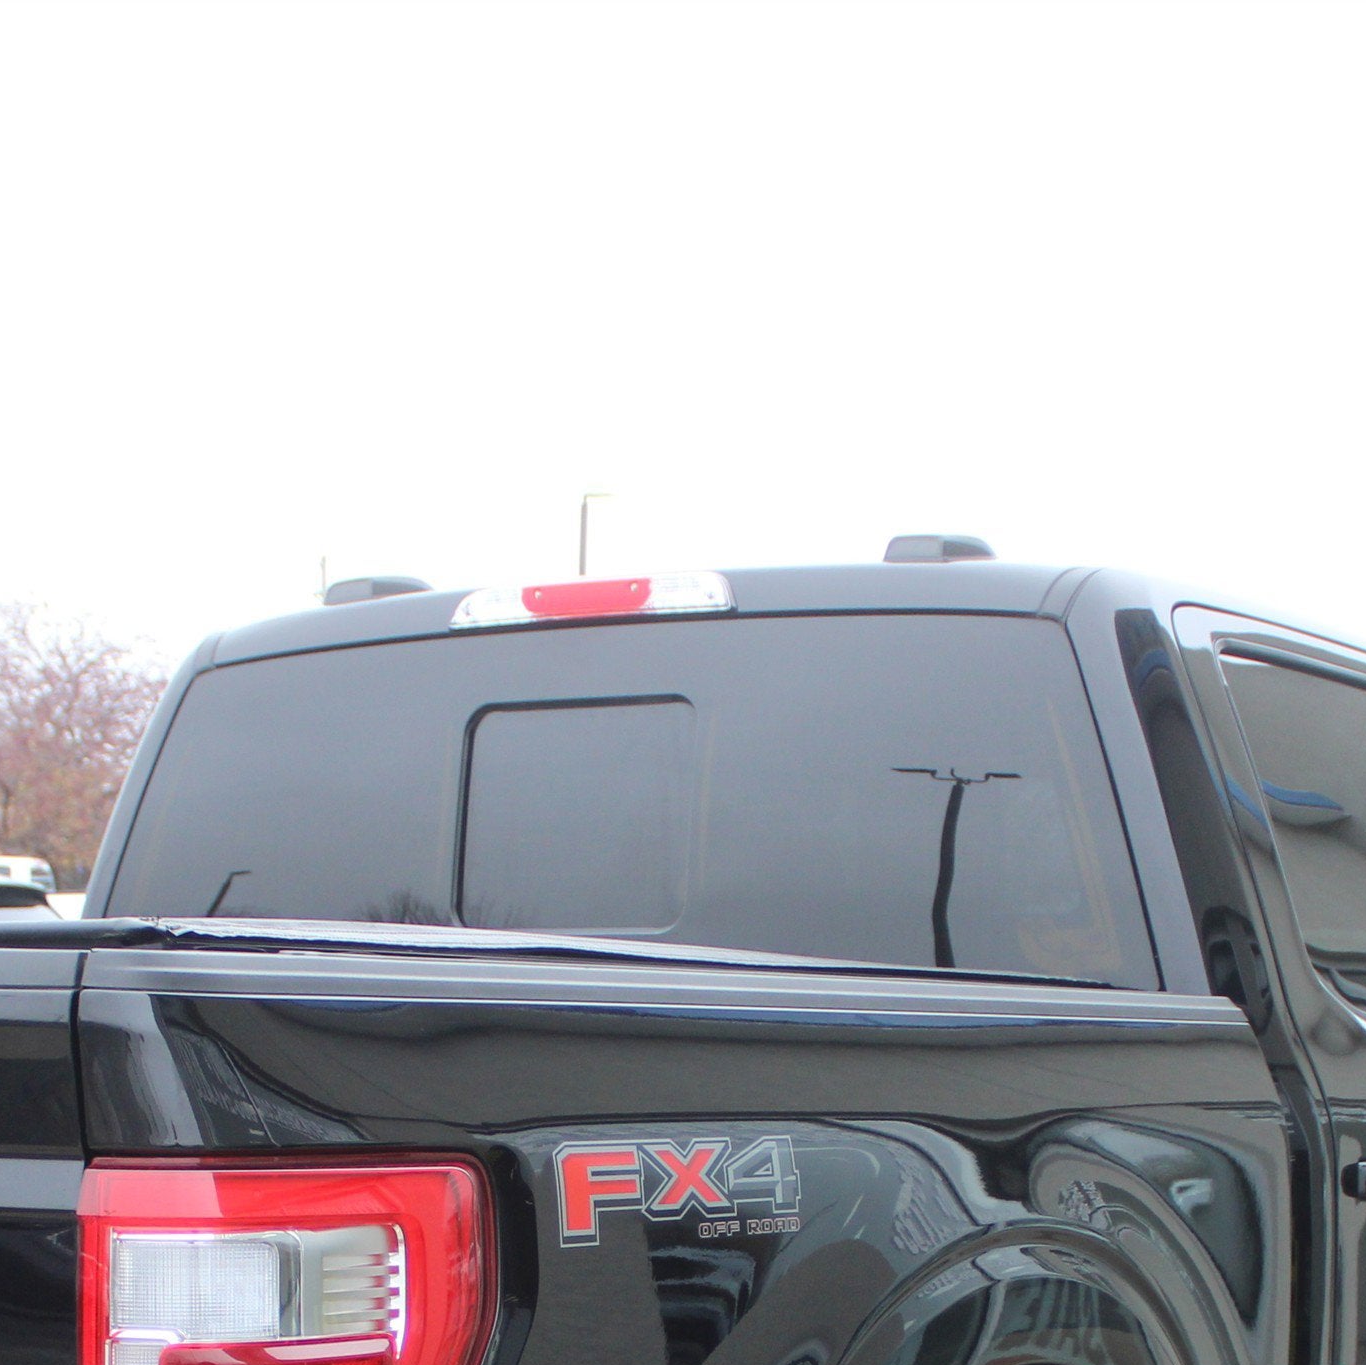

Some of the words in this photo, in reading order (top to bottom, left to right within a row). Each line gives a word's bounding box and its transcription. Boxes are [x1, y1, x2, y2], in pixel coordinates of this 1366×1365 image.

[553, 1135, 801, 1248] FX4
[699, 1219, 741, 1238] OFF
[747, 1216, 801, 1235] ROAD
